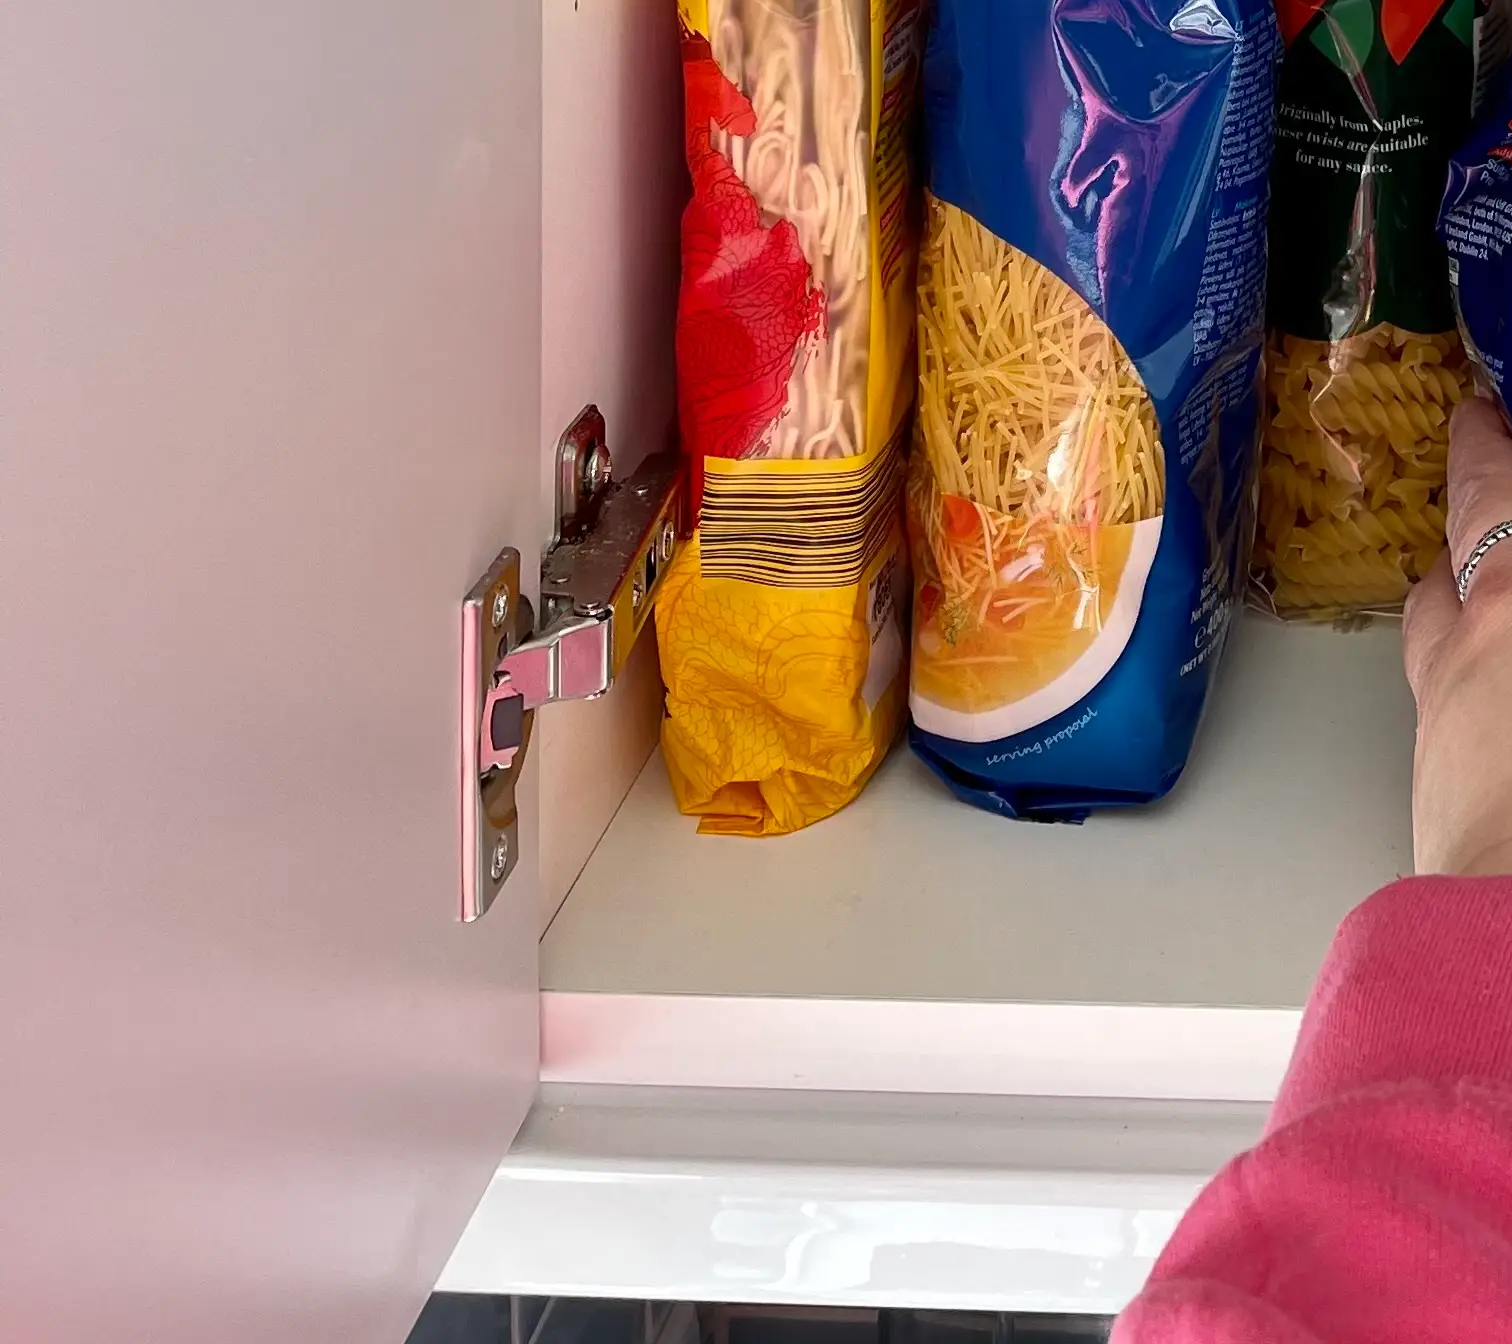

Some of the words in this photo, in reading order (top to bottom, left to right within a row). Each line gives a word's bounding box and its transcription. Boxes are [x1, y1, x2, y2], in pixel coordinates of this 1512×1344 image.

[1340, 116, 1368, 132] from
[1307, 127, 1344, 148] twists
[1318, 155, 1342, 173] any
[986, 741, 1043, 766] serving
[1045, 707, 1098, 750] proposal
